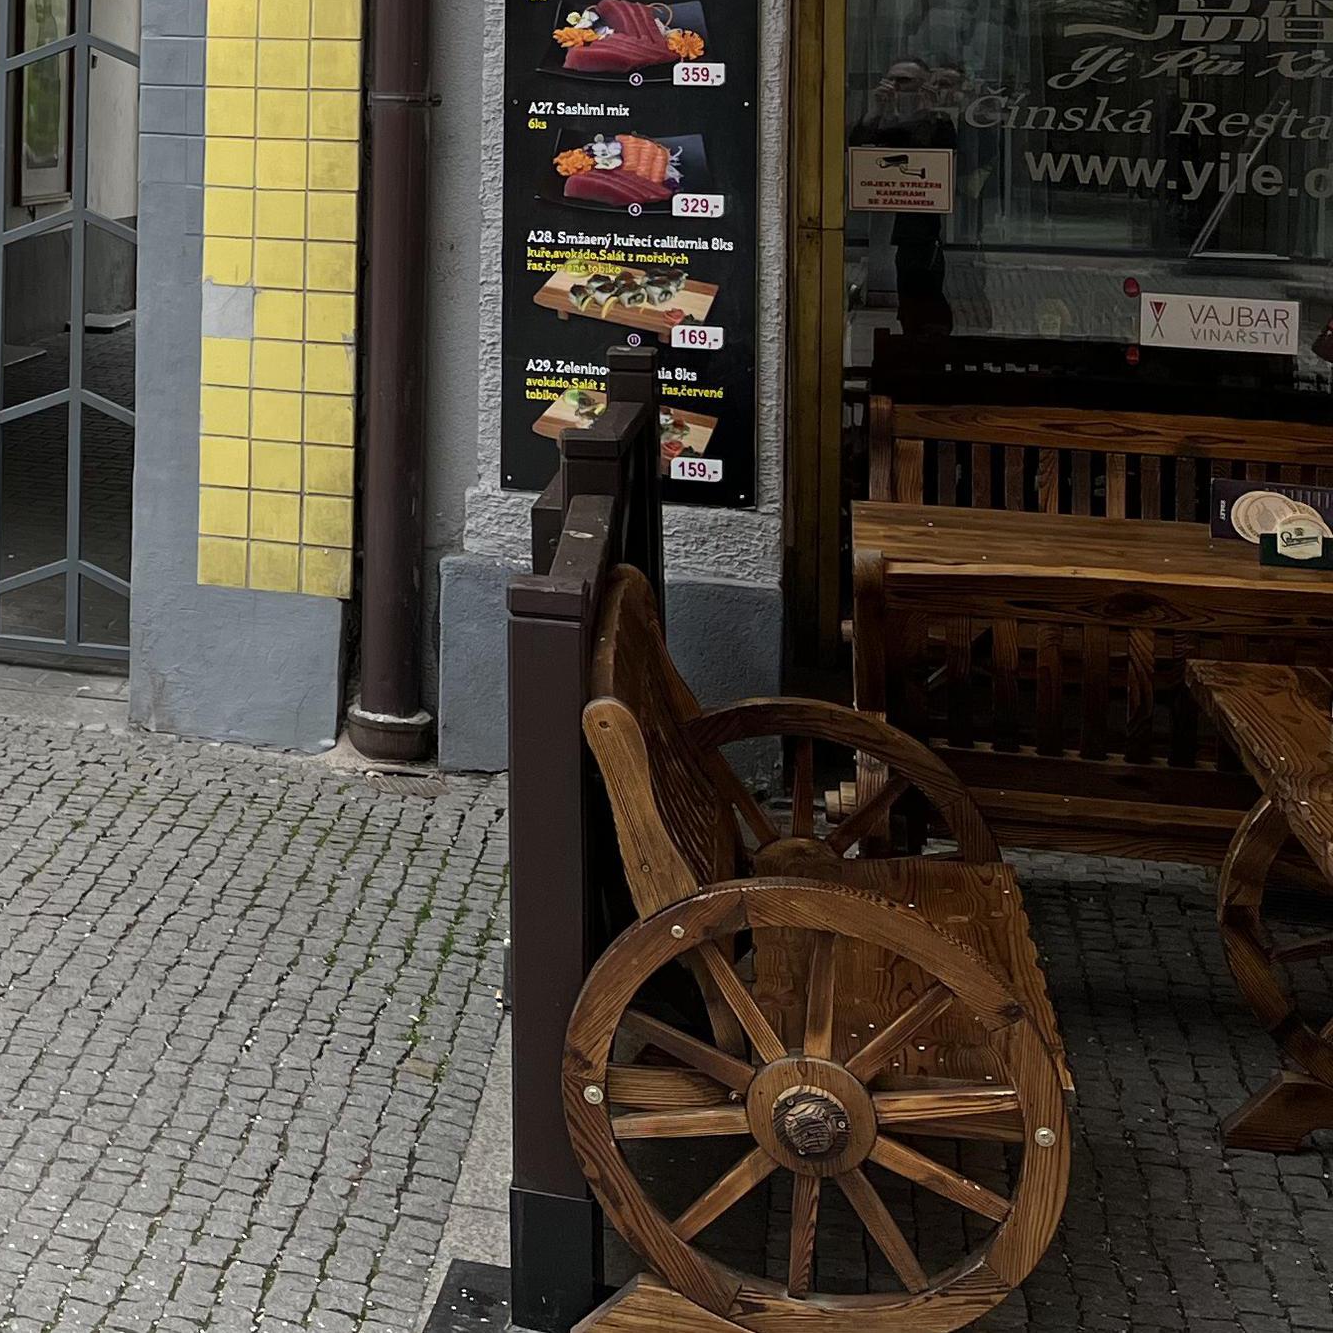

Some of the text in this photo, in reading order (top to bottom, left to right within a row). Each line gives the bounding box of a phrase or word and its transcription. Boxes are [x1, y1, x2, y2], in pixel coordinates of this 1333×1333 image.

[681, 66, 722, 85] 359,-
[528, 102, 630, 117] A27. Sashimi mix
[964, 86, 1155, 135] Čínská
[860, 180, 897, 188] OBJEKT
[876, 190, 926, 198] KAMERAMI
[680, 197, 721, 217] 329,-
[527, 230, 555, 244] A28.
[613, 234, 652, 249] kuřecí
[653, 235, 709, 251] california
[711, 237, 734, 252] 8ks
[628, 254, 634, 263] z
[635, 252, 689, 267] mořských
[1188, 303, 1290, 330] VAJBAR
[679, 329, 719, 349] 169,-
[1190, 327, 1290, 346] VINAŘSTVÍ
[526, 359, 555, 373] A29.
[674, 368, 697, 383] 8ks
[599, 382, 606, 392] z
[677, 462, 719, 481] 159,-
